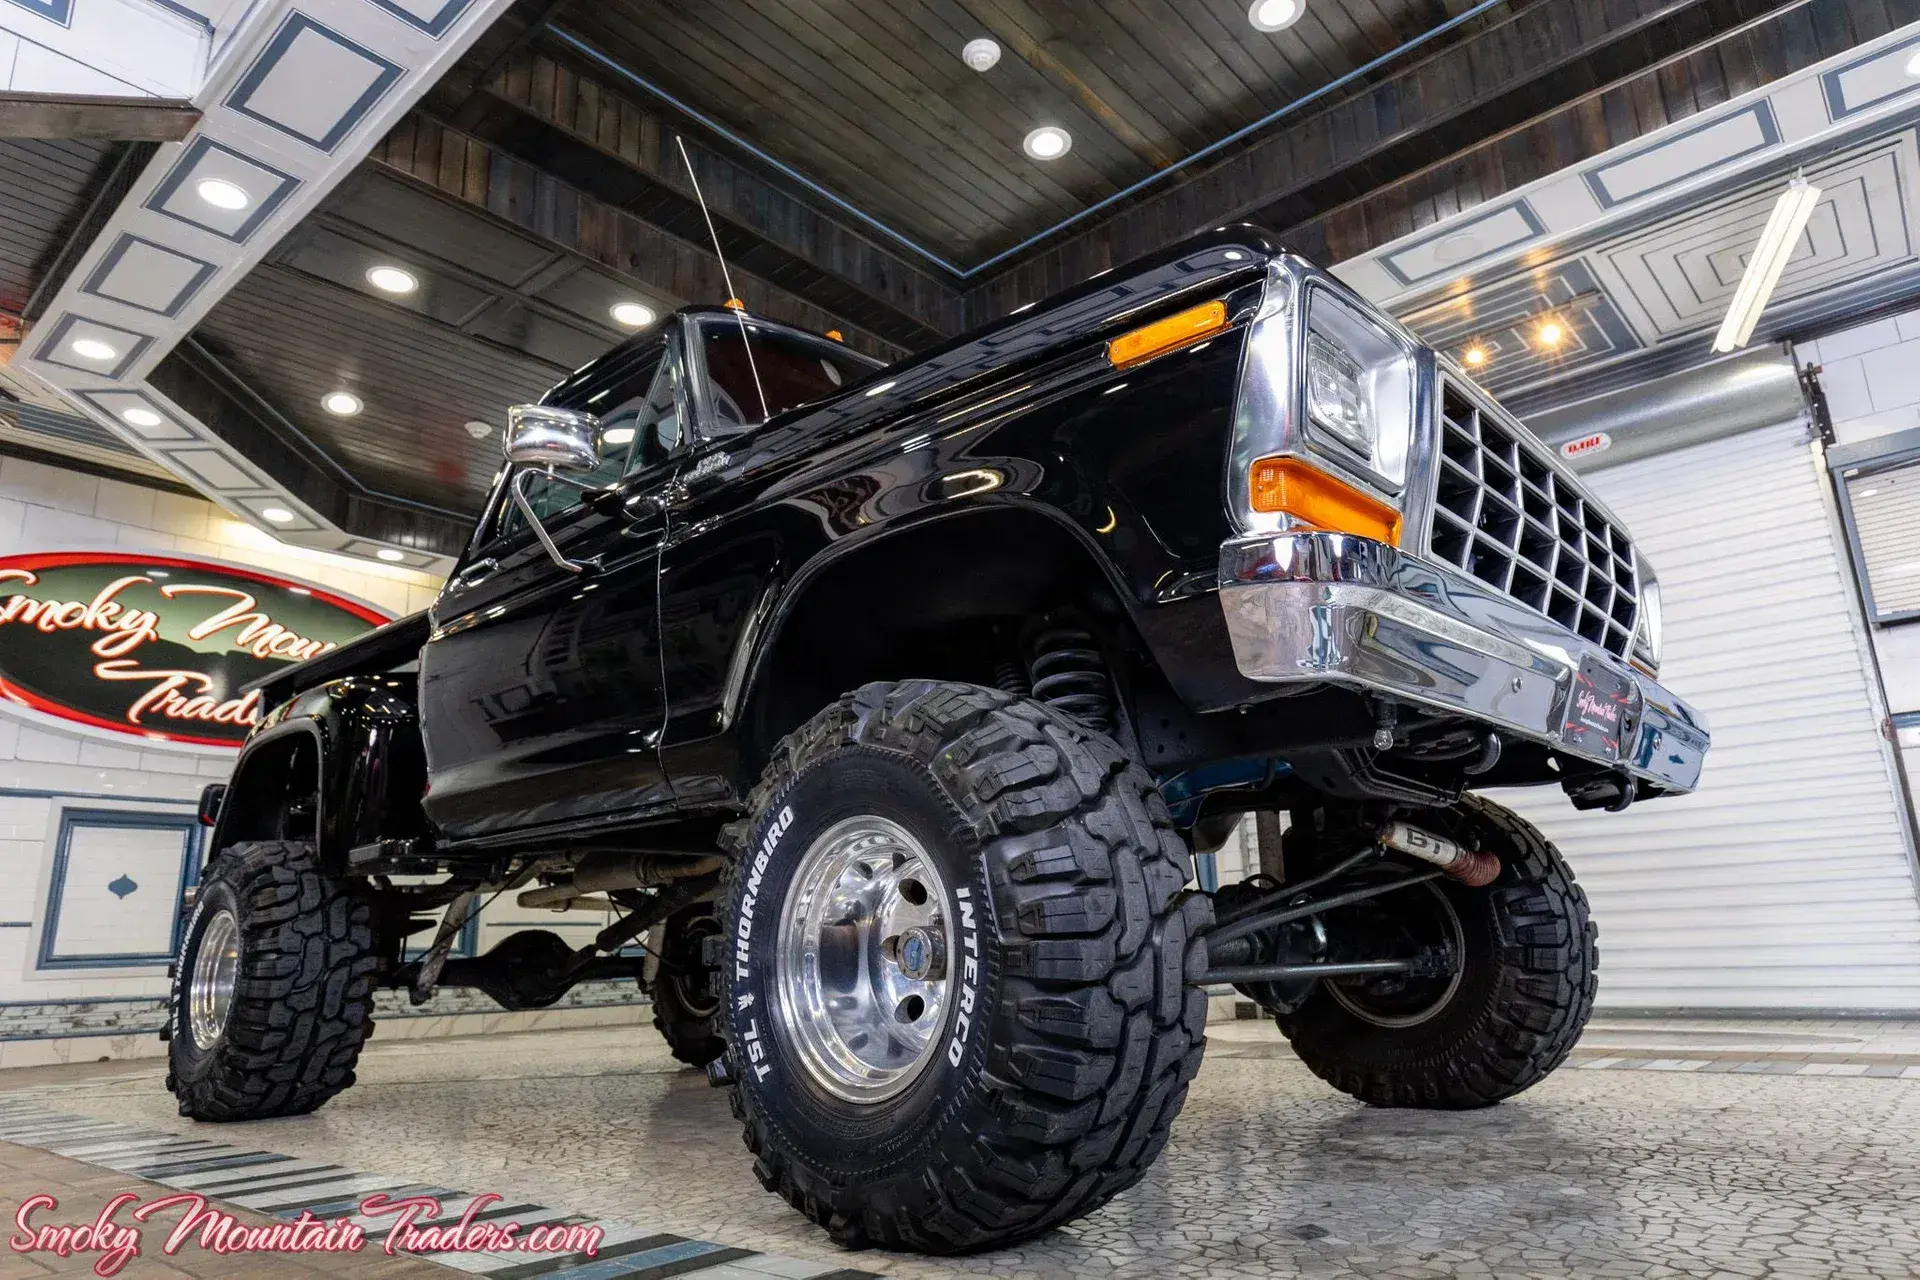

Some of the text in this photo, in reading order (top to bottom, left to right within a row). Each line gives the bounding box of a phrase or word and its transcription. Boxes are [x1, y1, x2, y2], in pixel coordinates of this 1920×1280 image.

[160, 583, 337, 660] Mou
[735, 805, 795, 1084] TSL THORNBIRD
[948, 887, 979, 1068] INTERCO
